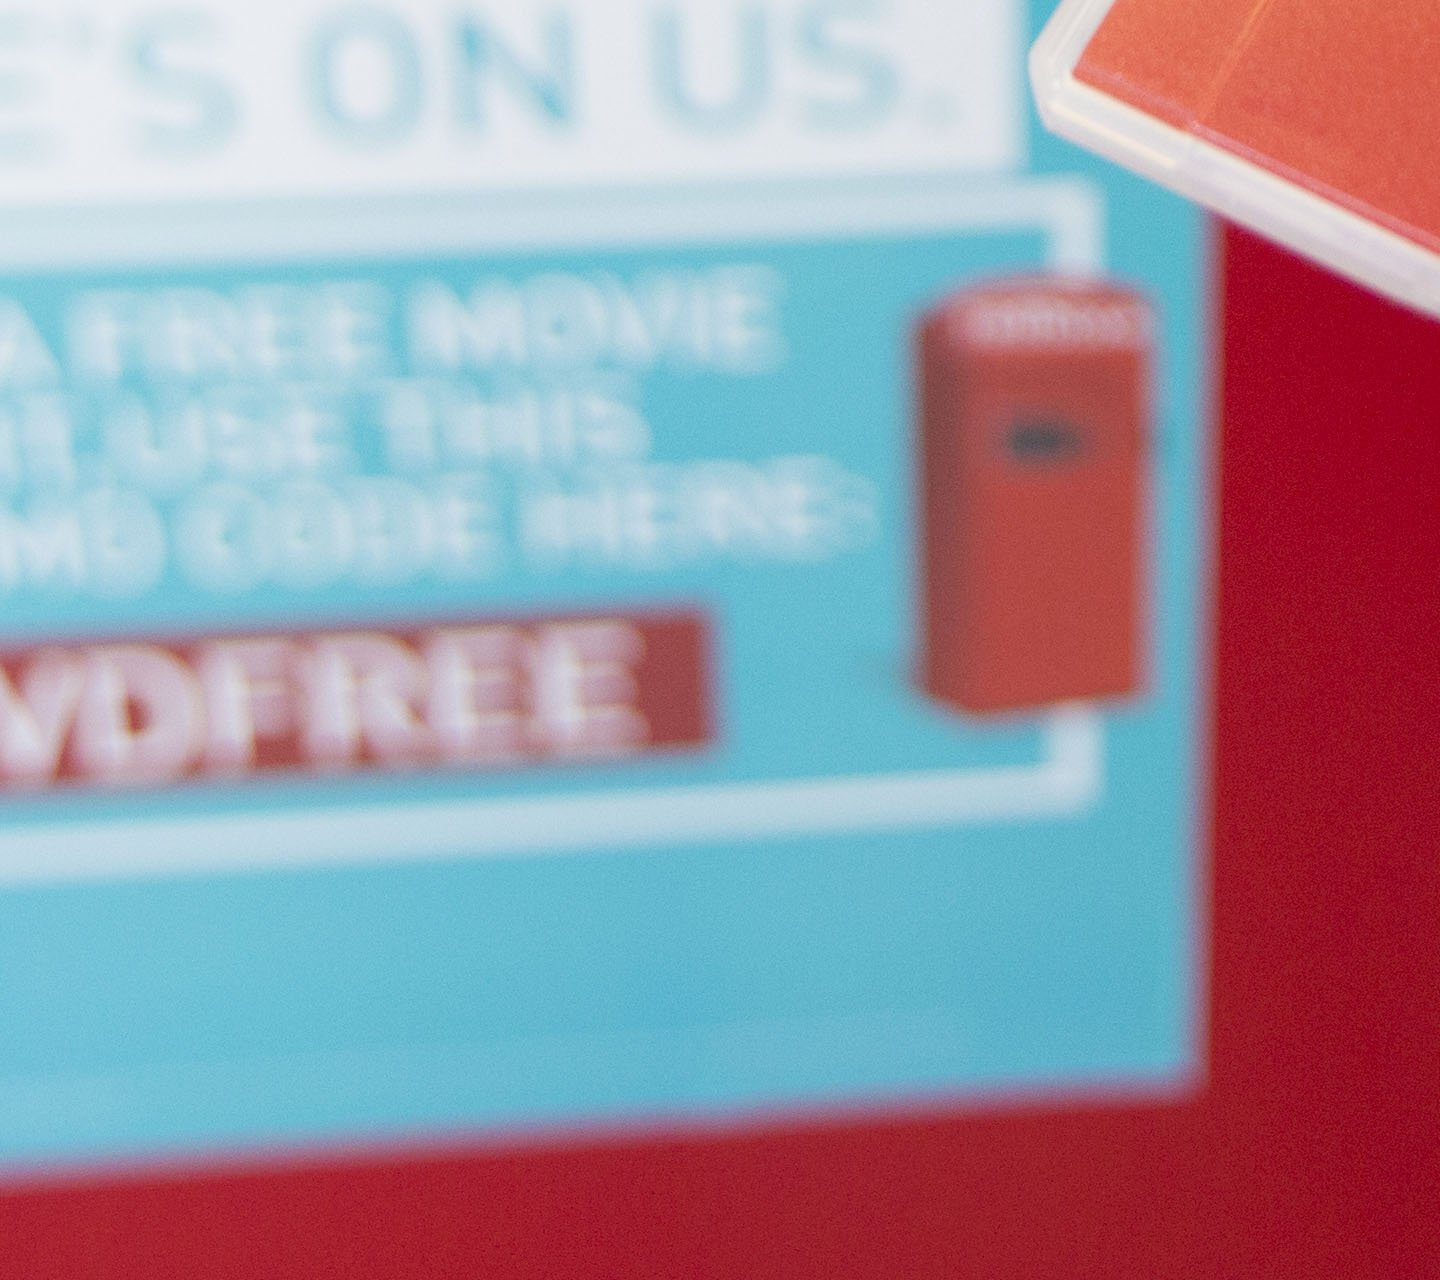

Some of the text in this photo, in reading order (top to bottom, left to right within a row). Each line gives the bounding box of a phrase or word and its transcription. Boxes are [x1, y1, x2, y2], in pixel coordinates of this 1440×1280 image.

[307, 0, 582, 154] ON
[68, 278, 394, 384] FREE
[404, 264, 790, 376] MOVIE
[105, 385, 351, 485] USE
[379, 373, 654, 468] THIS
[178, 469, 504, 592] CODE
